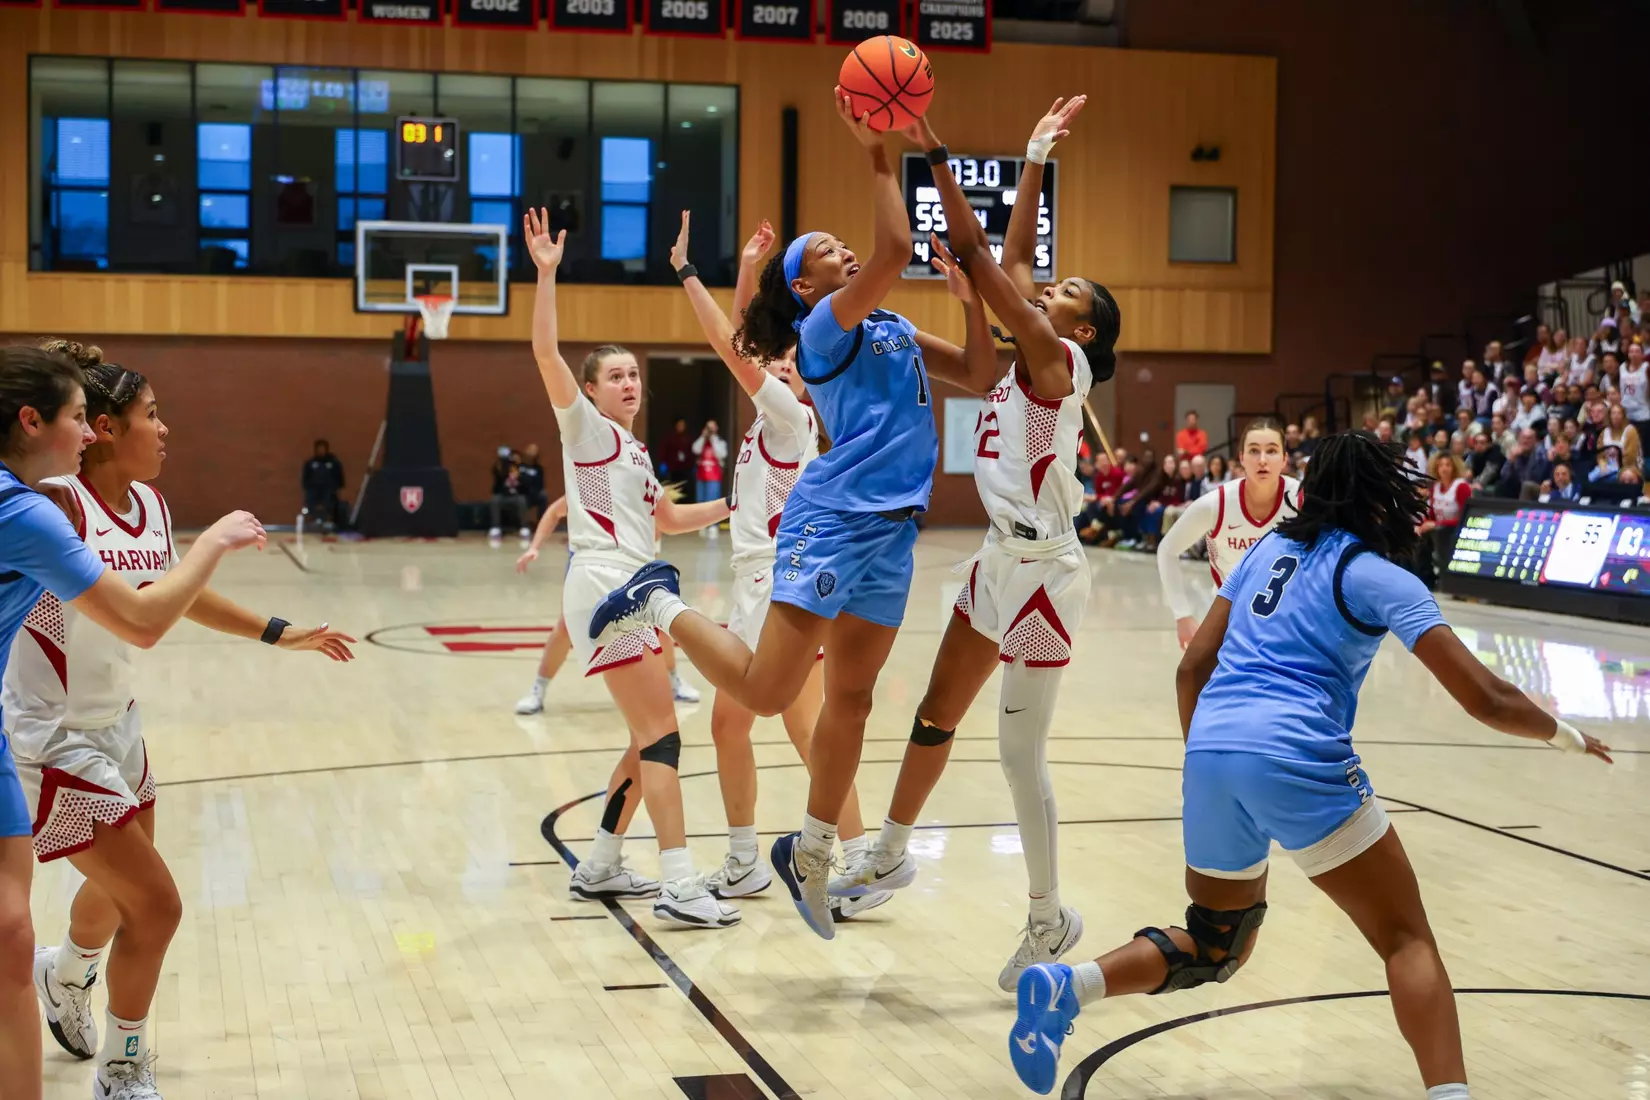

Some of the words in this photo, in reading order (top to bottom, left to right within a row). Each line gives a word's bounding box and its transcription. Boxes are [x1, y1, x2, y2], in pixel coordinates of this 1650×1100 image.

[372, 5, 430, 19] WOMEN
[566, 0, 615, 15] 2003
[661, 0, 709, 20] 2005
[752, 5, 799, 26] 2007
[843, 10, 889, 29] 2008
[930, 21, 974, 40] 2025
[914, 242, 929, 262] 4
[913, 355, 927, 406] 1
[974, 410, 1000, 459] 2
[1250, 555, 1298, 618] 3
